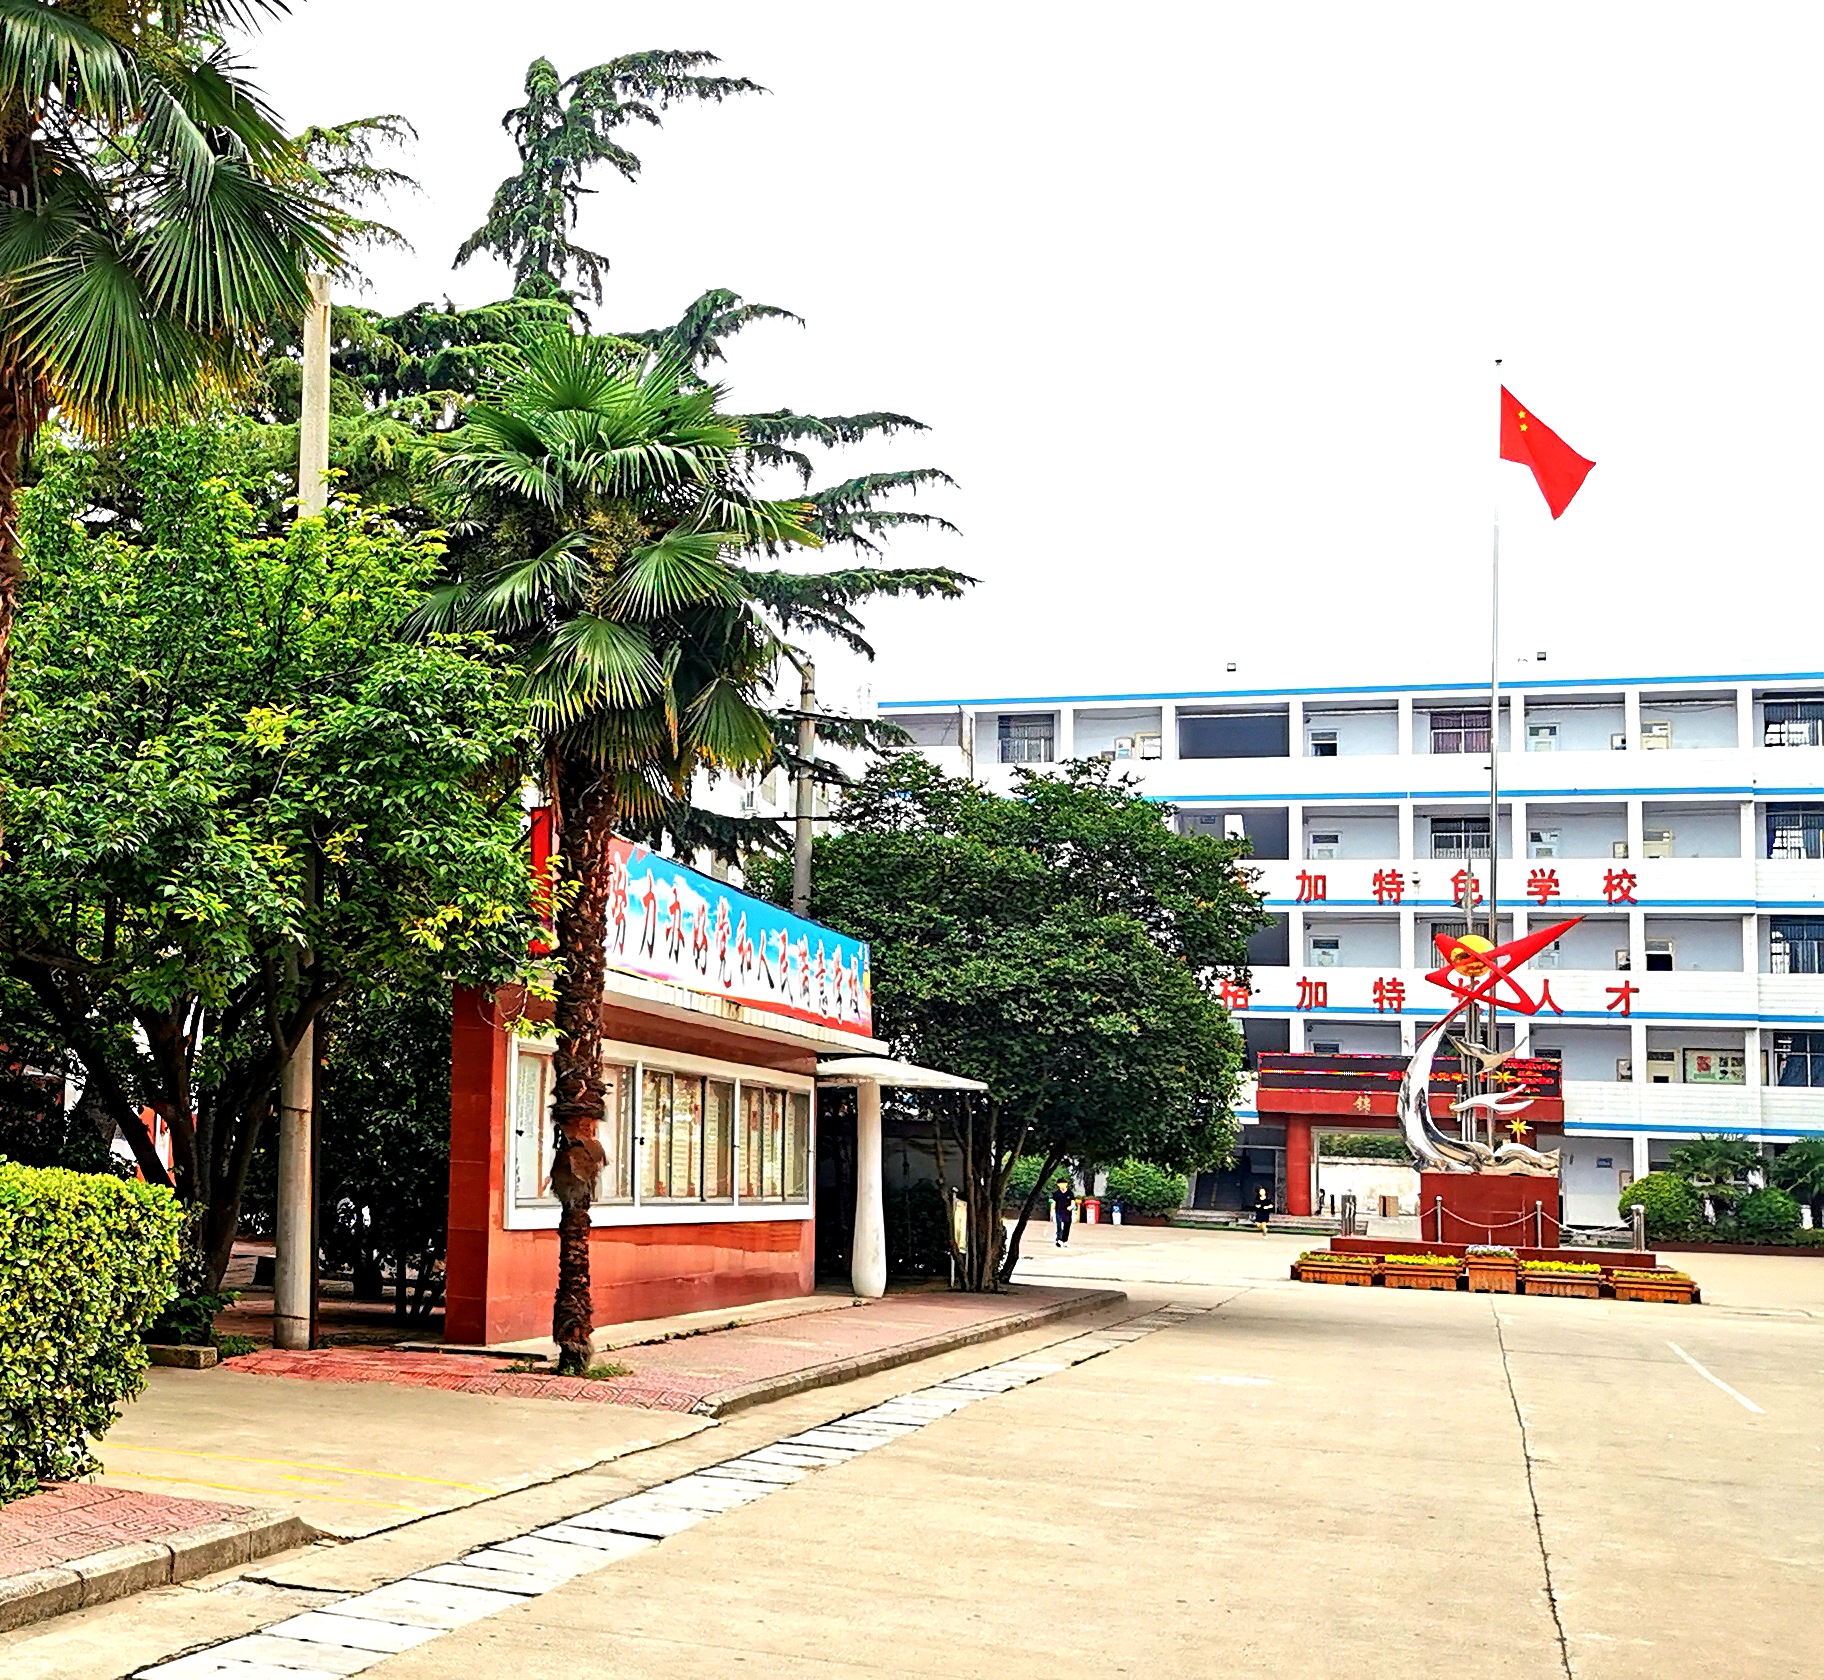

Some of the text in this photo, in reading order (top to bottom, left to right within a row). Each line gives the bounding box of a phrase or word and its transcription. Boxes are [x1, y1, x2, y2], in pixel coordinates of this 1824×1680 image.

[1234, 868, 1638, 905] 加特色学校
